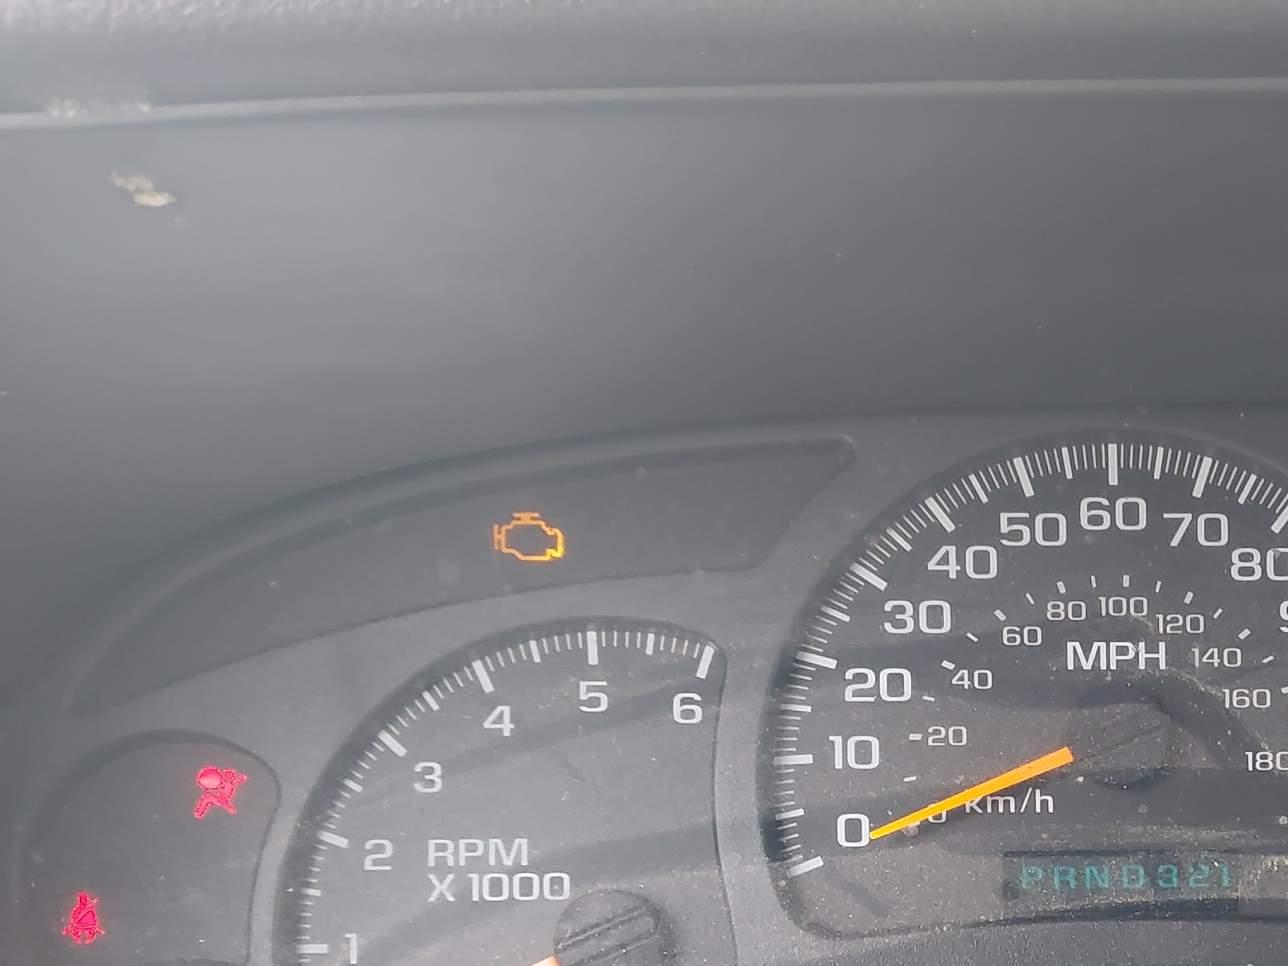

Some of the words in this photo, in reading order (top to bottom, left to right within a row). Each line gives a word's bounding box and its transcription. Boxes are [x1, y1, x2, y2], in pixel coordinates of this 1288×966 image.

[1000, 512, 1068, 547] 50
[1079, 497, 1147, 531] 60
[1162, 513, 1229, 548] 70
[927, 545, 999, 580] 40
[883, 600, 952, 635] 30
[1046, 601, 1087, 622] 80
[1098, 596, 1148, 617] 100
[1002, 625, 1043, 647] 60
[1156, 613, 1205, 635] 120
[1066, 641, 1167, 671] MPH
[1191, 646, 1243, 668] 140
[844, 668, 913, 703] 20
[951, 668, 993, 690] 40
[578, 681, 608, 713] 5
[672, 693, 703, 725] 6
[1222, 688, 1271, 709] 160
[483, 705, 515, 737] 4
[927, 725, 968, 747] 20
[829, 735, 880, 770] 10
[413, 762, 443, 793] 3
[965, 787, 1054, 814] km/h
[836, 813, 870, 848] 0
[364, 840, 393, 871] 2
[427, 838, 529, 867] RPM
[427, 874, 455, 902] X
[467, 873, 570, 902] 1000
[345, 933, 358, 965] 1
